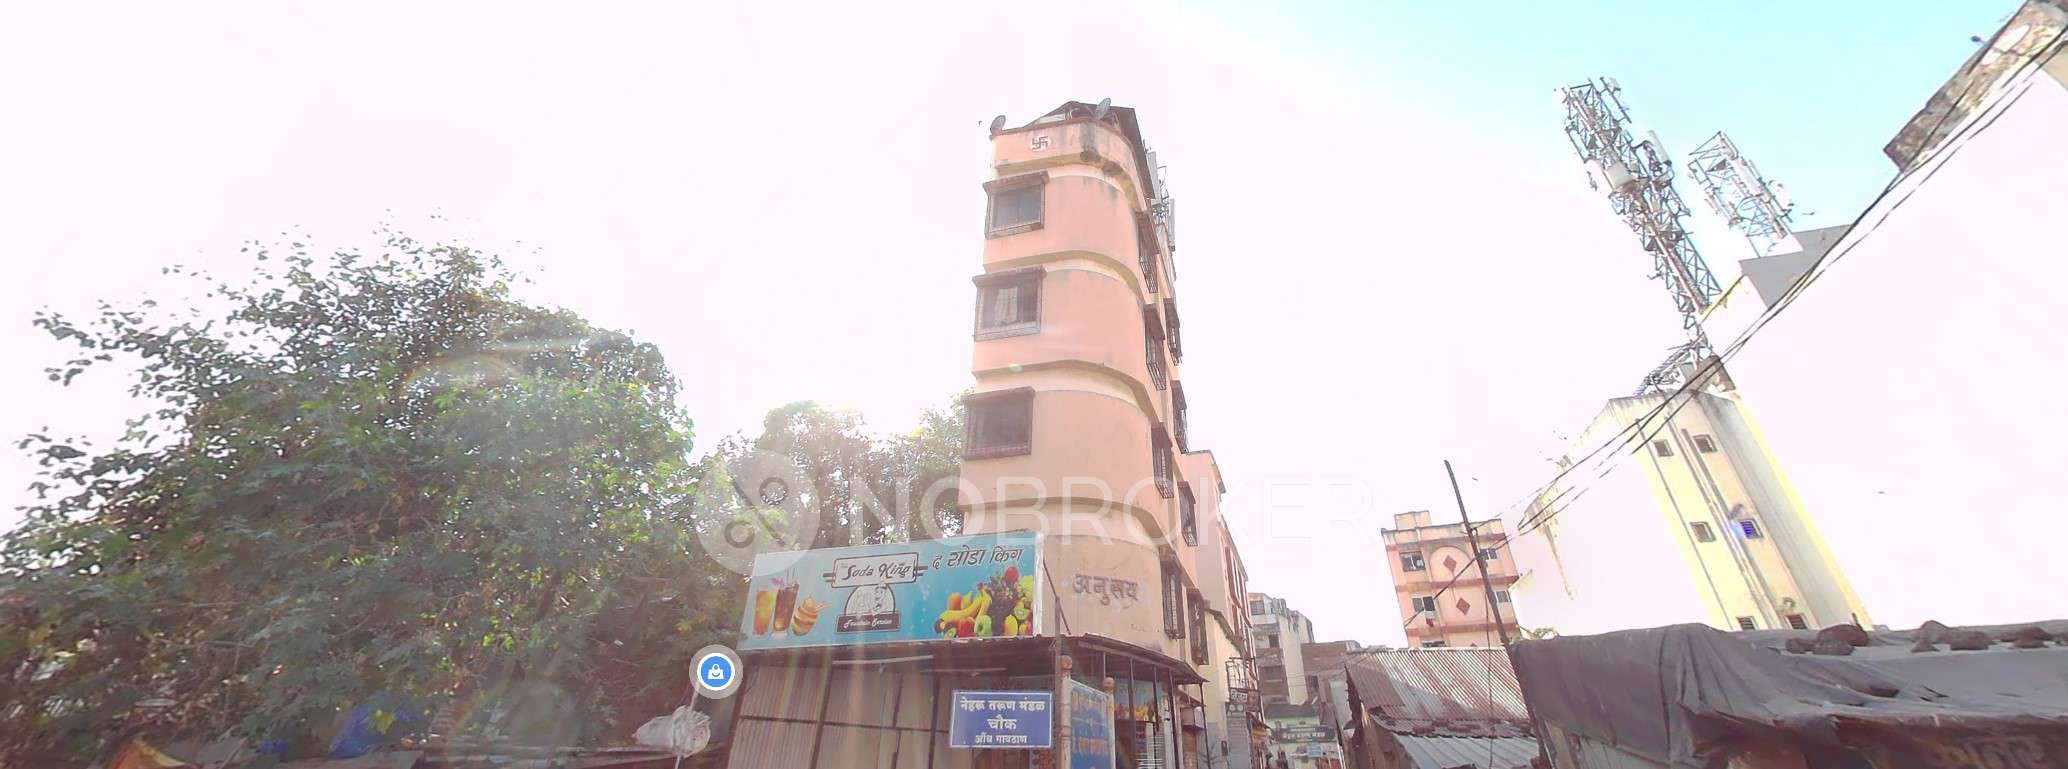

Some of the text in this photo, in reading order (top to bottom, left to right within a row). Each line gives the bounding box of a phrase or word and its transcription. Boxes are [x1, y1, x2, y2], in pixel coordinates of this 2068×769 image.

[932, 544, 1025, 570] द सोडा किंग
[841, 564, 873, 581] Soda
[878, 562, 912, 579] King
[1018, 697, 1045, 711] मंडळ
[987, 714, 1017, 730] चौक
